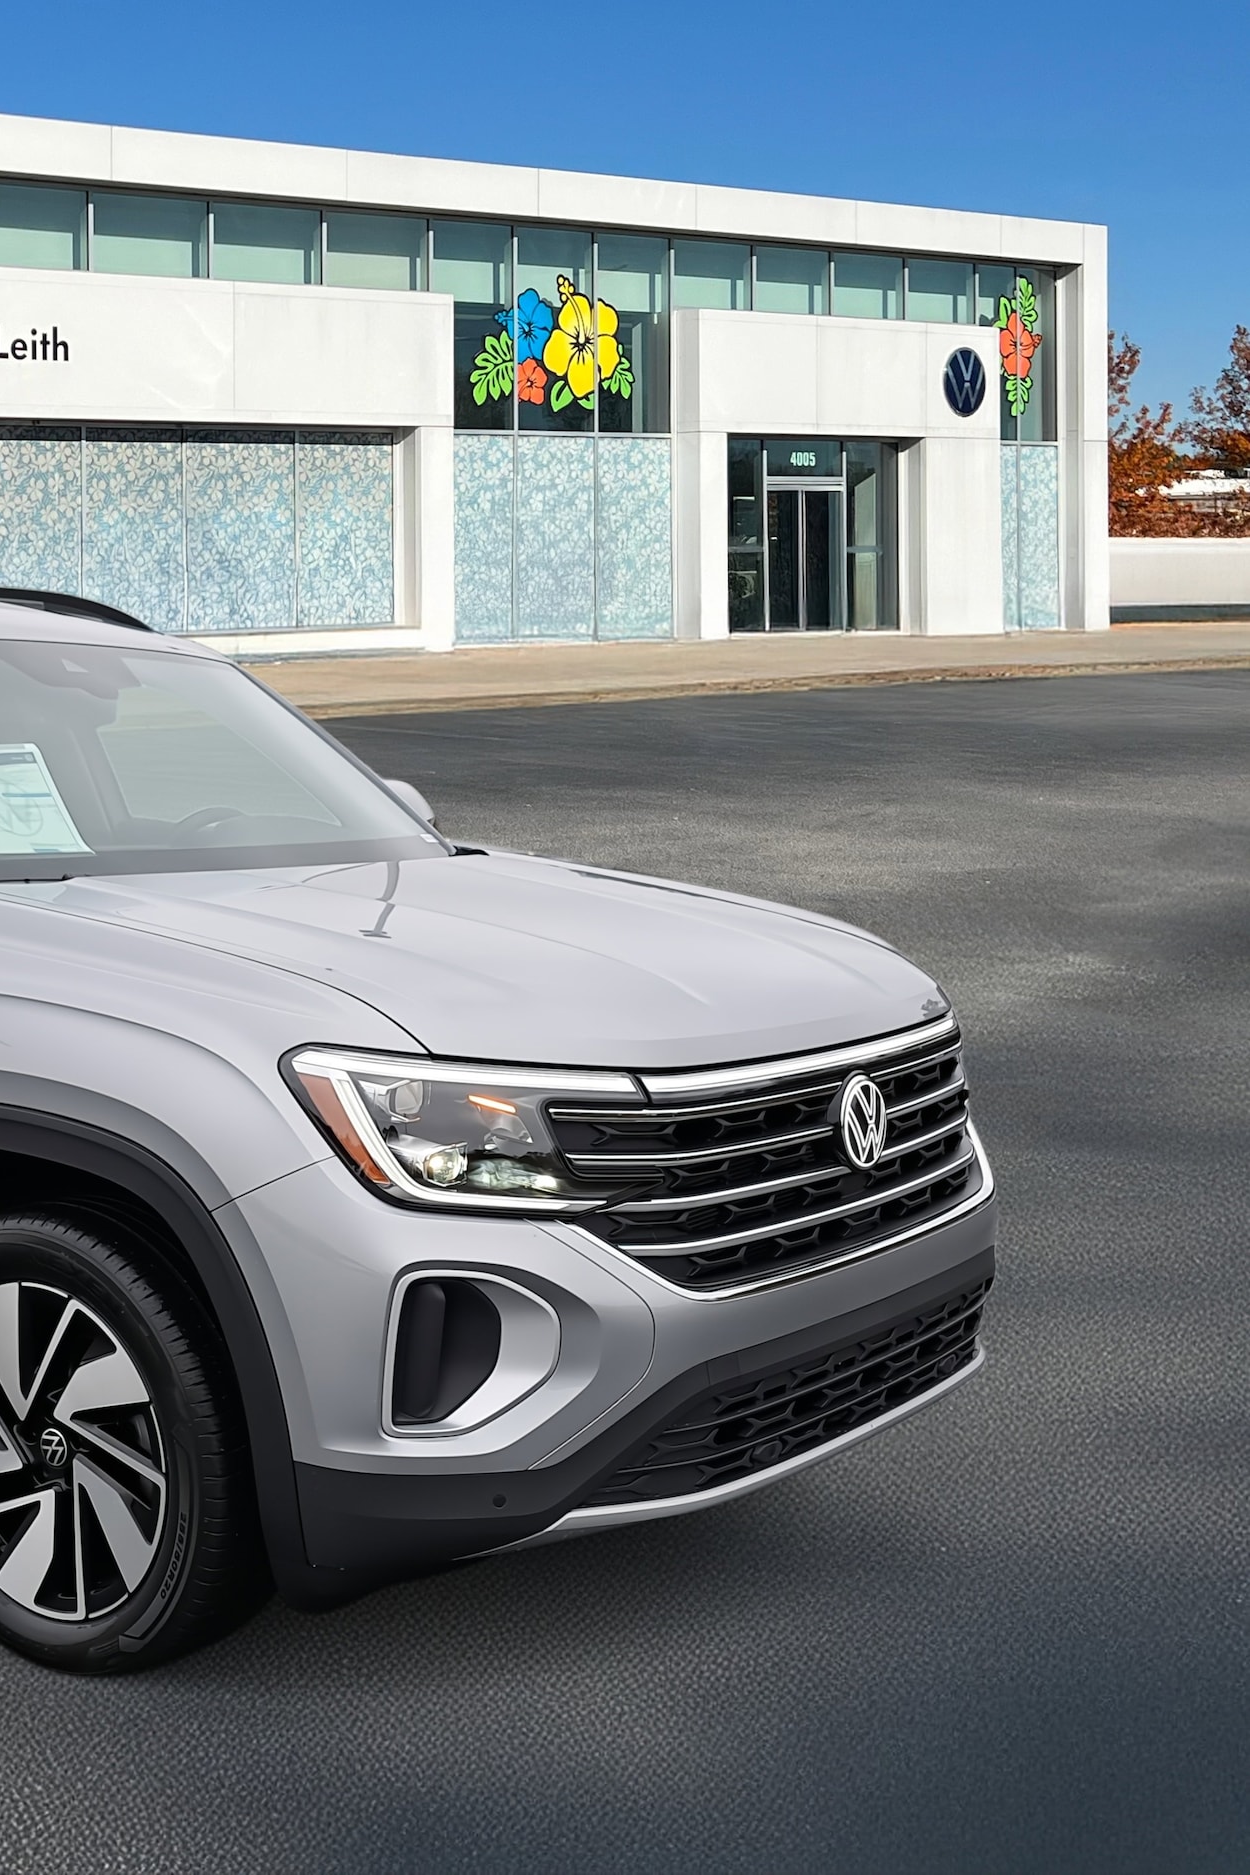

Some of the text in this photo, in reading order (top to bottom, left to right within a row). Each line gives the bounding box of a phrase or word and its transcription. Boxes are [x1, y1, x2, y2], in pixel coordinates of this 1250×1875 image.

[943, 347, 986, 417] VW
[790, 452, 816, 467] 4005
[841, 1074, 887, 1169] VW
